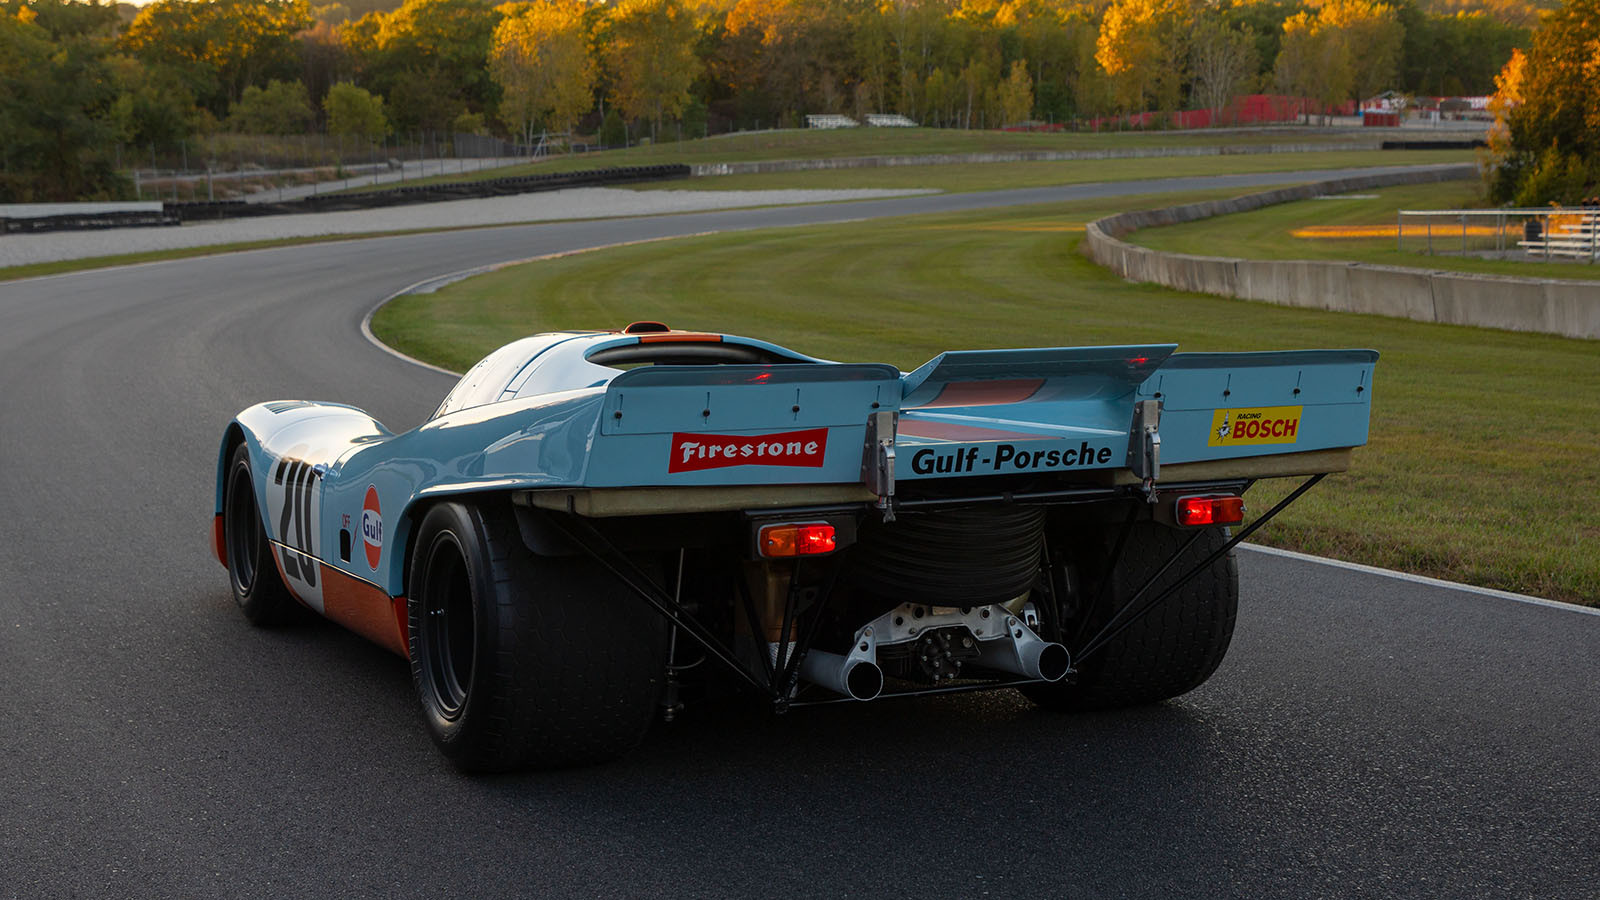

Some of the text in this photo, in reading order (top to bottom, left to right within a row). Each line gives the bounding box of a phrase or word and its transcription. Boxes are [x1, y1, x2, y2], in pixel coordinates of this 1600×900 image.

[1232, 418, 1298, 439] BOSCH
[679, 441, 819, 463] Firestone
[911, 442, 1112, 474] Gulf-Porsche
[274, 455, 316, 588] 20
[362, 513, 382, 542] Gulf
